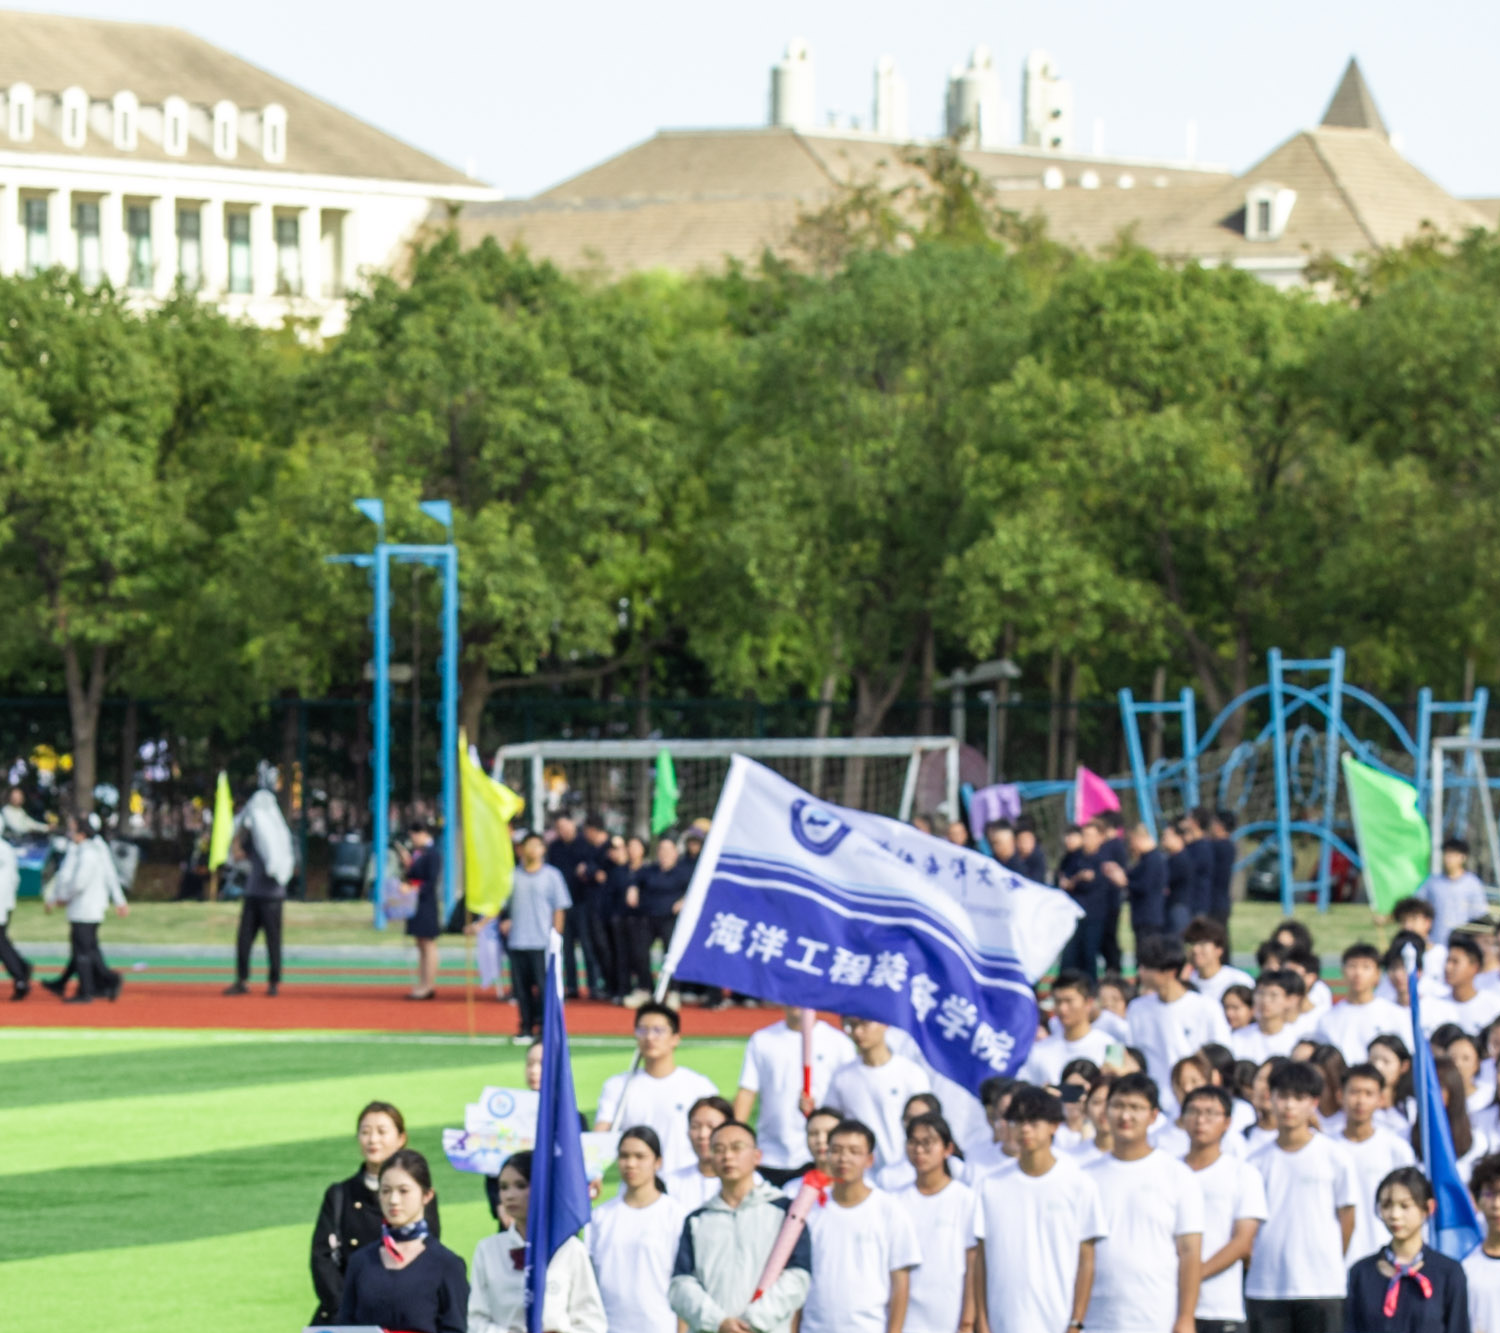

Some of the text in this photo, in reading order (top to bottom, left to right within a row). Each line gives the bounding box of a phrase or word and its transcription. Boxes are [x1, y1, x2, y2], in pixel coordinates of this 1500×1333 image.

[704, 911, 1017, 1072] 海洋工程装备学院
